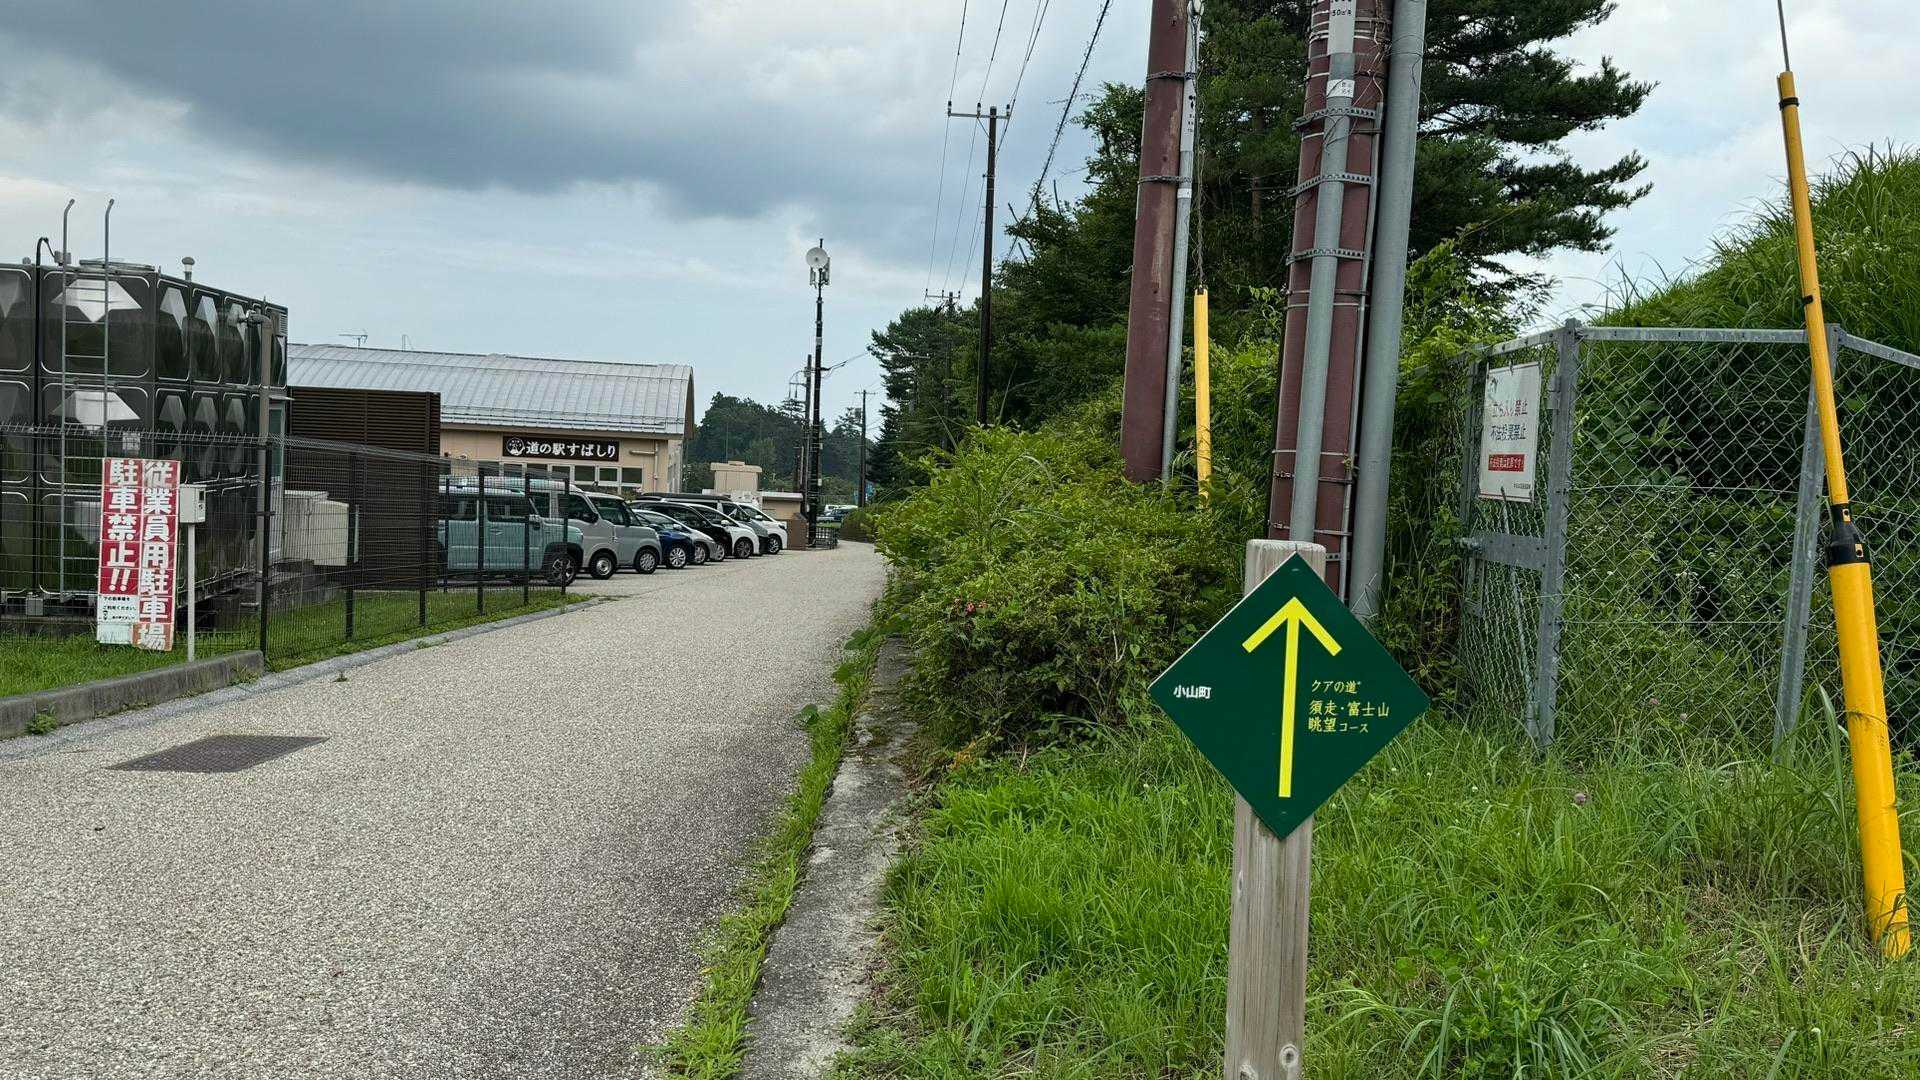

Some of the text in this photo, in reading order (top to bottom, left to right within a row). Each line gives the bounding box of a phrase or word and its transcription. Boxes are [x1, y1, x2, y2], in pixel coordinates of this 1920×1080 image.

[525, 441, 616, 458] 道の駅すばしり
[138, 460, 174, 650] 従業員用駐車場
[1173, 684, 1212, 700] 小山町
[1308, 700, 1390, 717] 須走・富士山
[1308, 716, 1369, 733] 眺望コース
